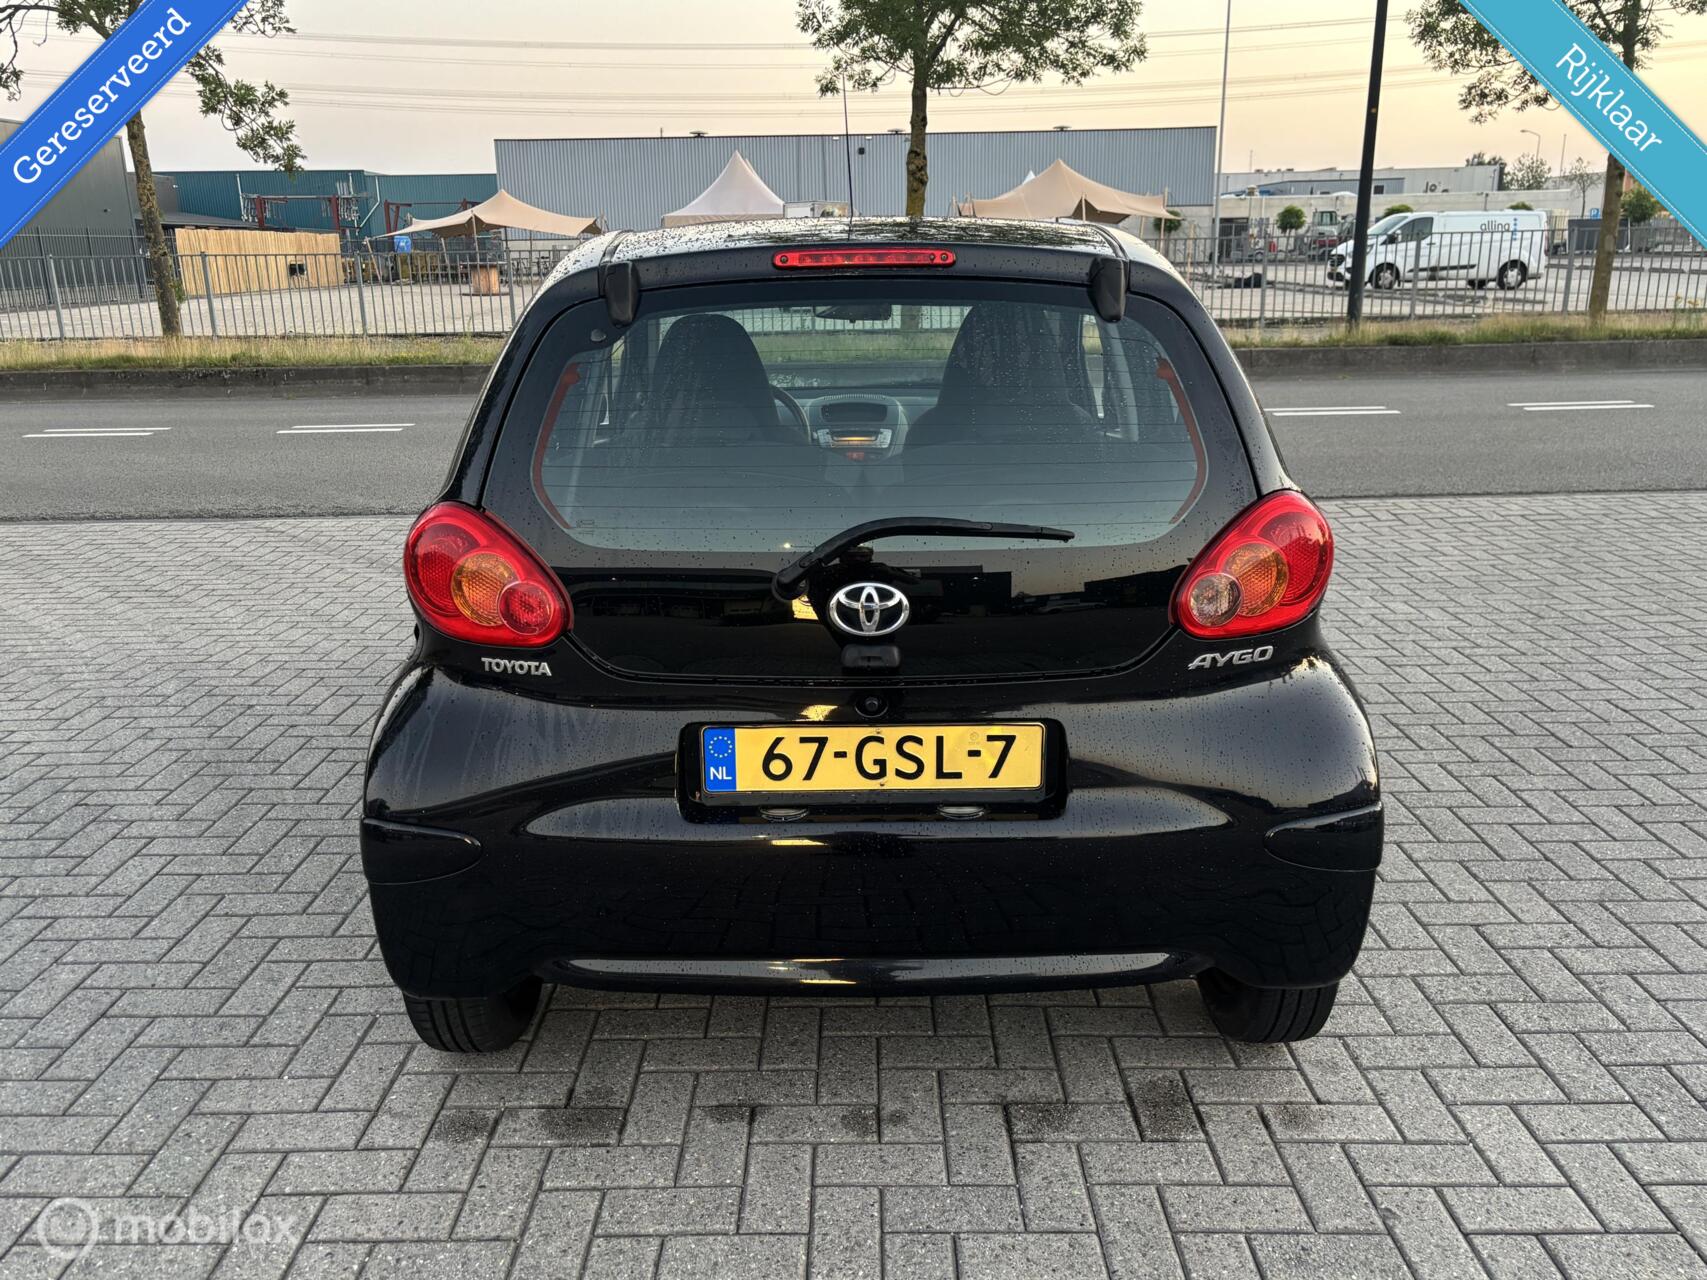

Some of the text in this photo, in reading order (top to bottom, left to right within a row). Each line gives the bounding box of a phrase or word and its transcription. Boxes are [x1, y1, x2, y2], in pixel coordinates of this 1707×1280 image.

[481, 657, 552, 676] TOYOTA
[1187, 645, 1274, 670] AYGO
[762, 735, 1016, 781] 67-GSL-7
[710, 766, 732, 780] NL
